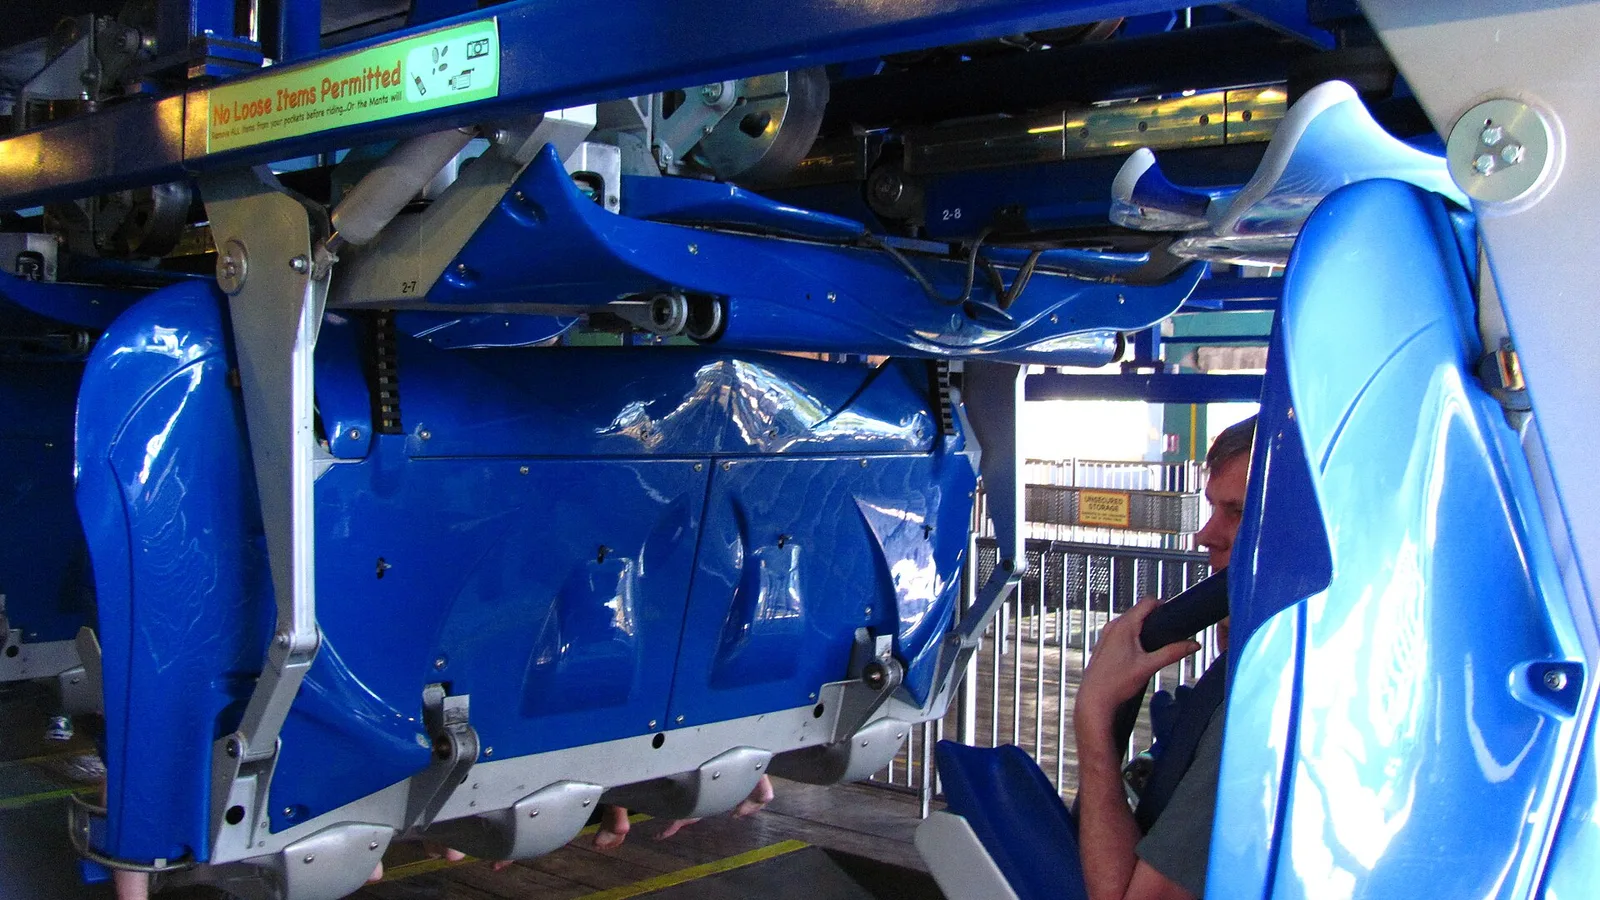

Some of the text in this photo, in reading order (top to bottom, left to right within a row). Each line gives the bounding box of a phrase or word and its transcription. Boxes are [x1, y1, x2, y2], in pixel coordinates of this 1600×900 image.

[213, 59, 402, 126] No Loose Items Permitted
[257, 121, 270, 130] from
[271, 119, 283, 129] your
[284, 113, 305, 127] pockets
[306, 109, 325, 120] before
[357, 100, 367, 108] the
[369, 95, 389, 106] Manta
[943, 208, 961, 220] 2-8
[402, 281, 417, 293] 2-7
[1084, 495, 1124, 505] UNSECURED
[1089, 503, 1119, 511] STORAGE
